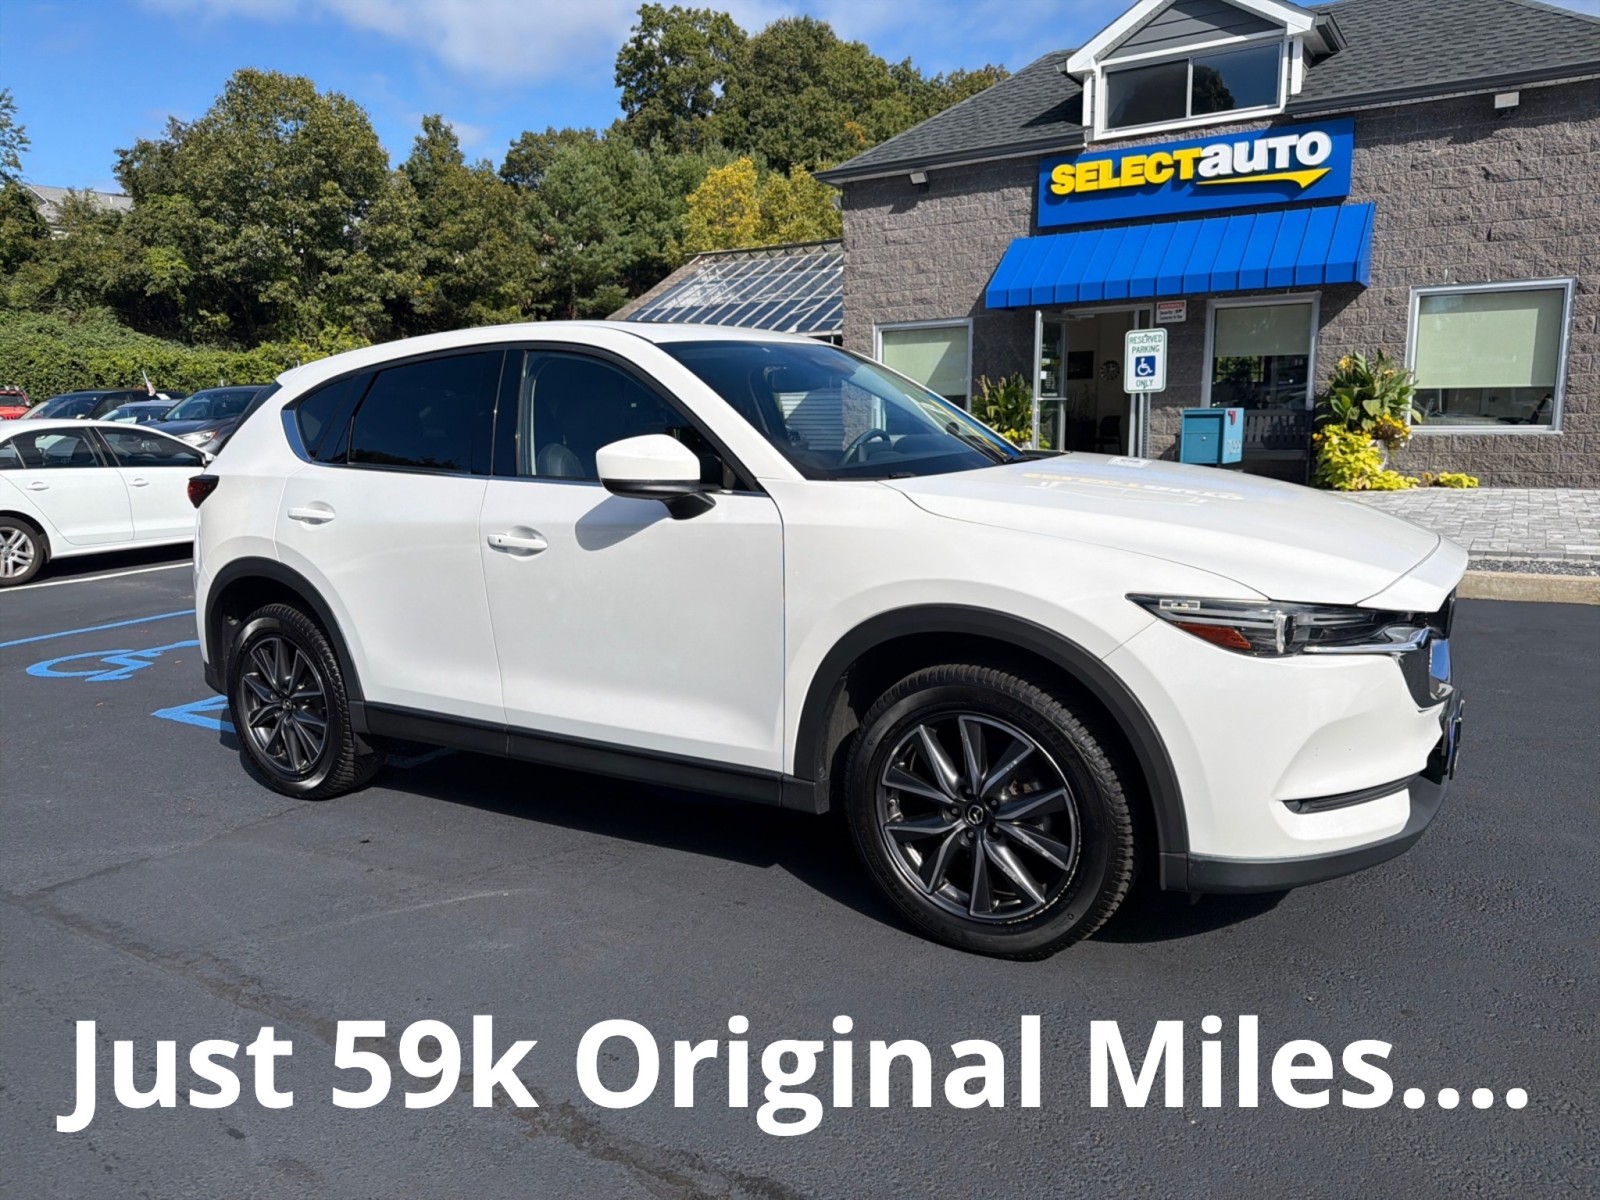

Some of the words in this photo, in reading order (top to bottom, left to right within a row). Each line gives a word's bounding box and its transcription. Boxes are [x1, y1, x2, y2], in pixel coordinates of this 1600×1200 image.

[1129, 335, 1162, 344] RESERVED
[1132, 345, 1160, 353] PARKING
[1136, 379, 1153, 387] ONLY
